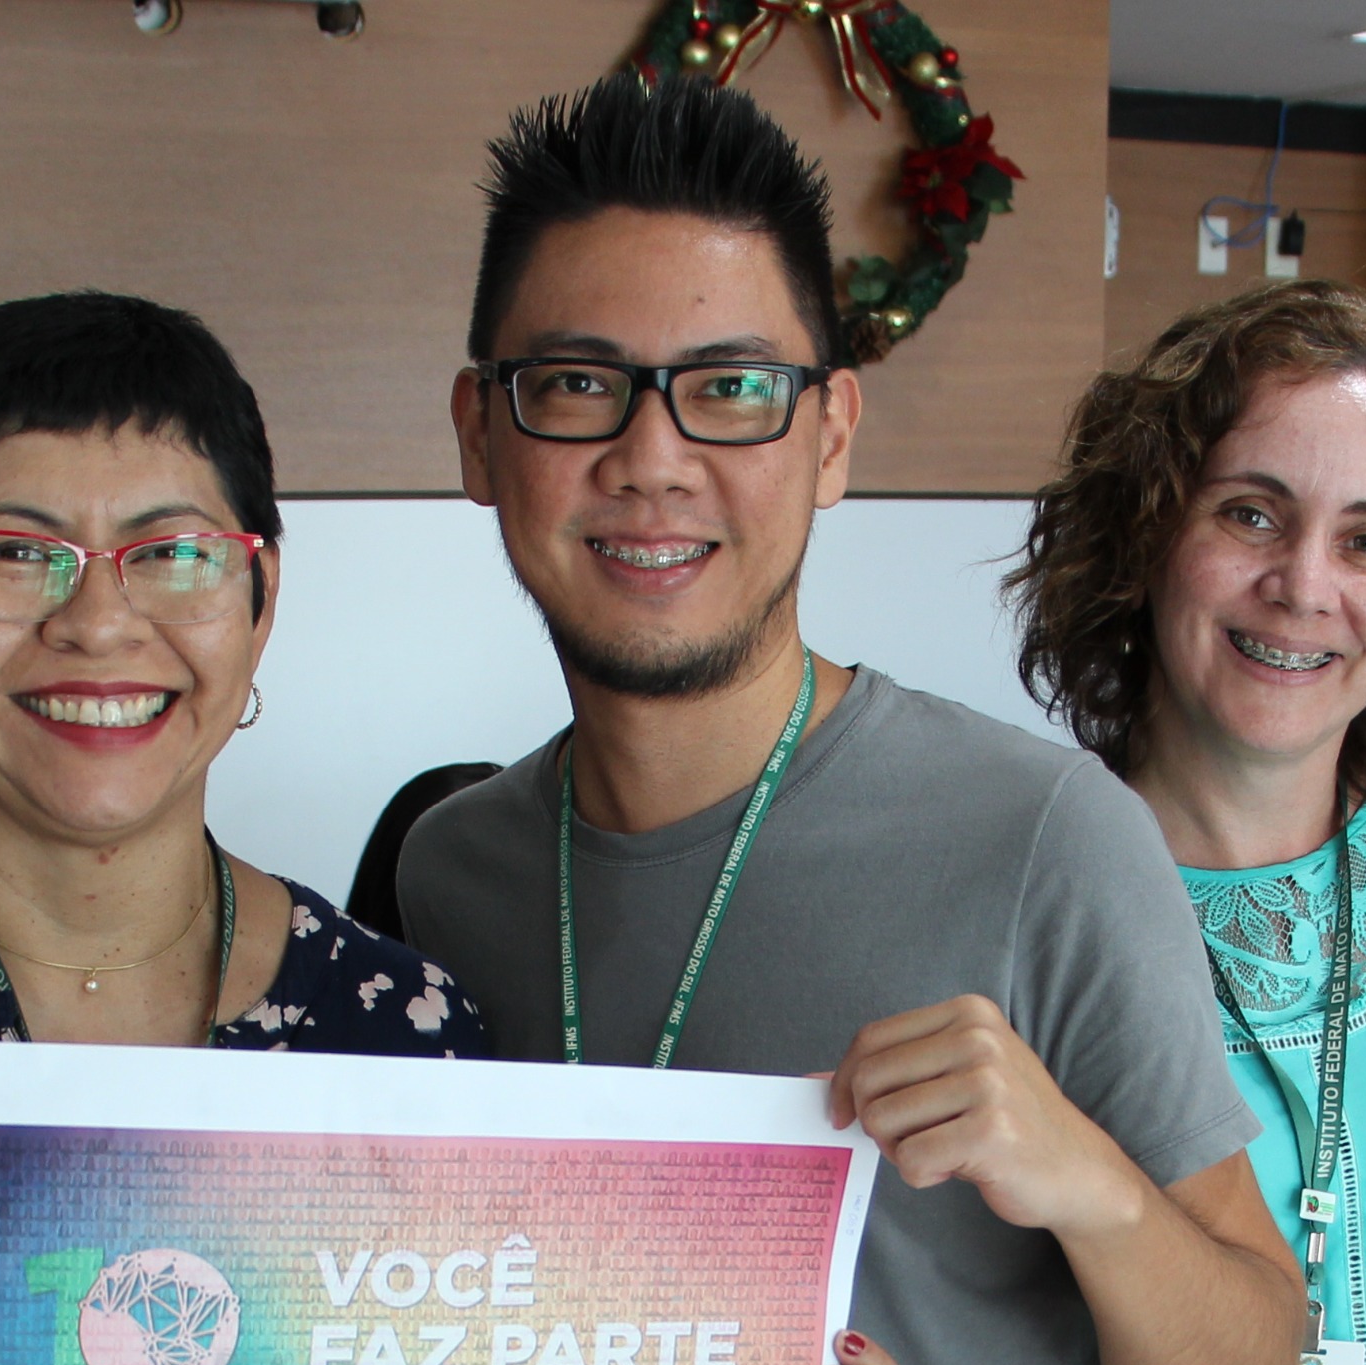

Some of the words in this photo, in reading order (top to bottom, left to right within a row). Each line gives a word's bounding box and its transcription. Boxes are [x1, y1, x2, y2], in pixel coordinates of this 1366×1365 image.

[789, 710, 803, 726] DO
[780, 725, 797, 743] SUL
[766, 749, 786, 774] IFMS
[742, 781, 771, 831] INSTITUTO
[561, 824, 568, 838] DO
[560, 840, 568, 877] GROSSO
[724, 830, 750, 873] FEDERAL
[560, 877, 570, 907] MATO
[718, 873, 732, 889] DE
[560, 908, 570, 921] DE
[708, 887, 726, 918] MATO
[561, 922, 572, 965] FEDERAL
[692, 917, 715, 959] GROSSO
[686, 958, 700, 975] DO
[1335, 932, 1348, 980] MATO
[562, 965, 576, 1016] INSTITUTO
[679, 973, 694, 994] SUL
[1331, 980, 1346, 1007] DE
[669, 999, 686, 1025] IFMS
[565, 1026, 578, 1051] IFMS
[1324, 1006, 1345, 1083] FEDERAL
[1317, 1086, 1340, 1178] INSTITUTO
[315, 1233, 538, 1309] VOCÊ
